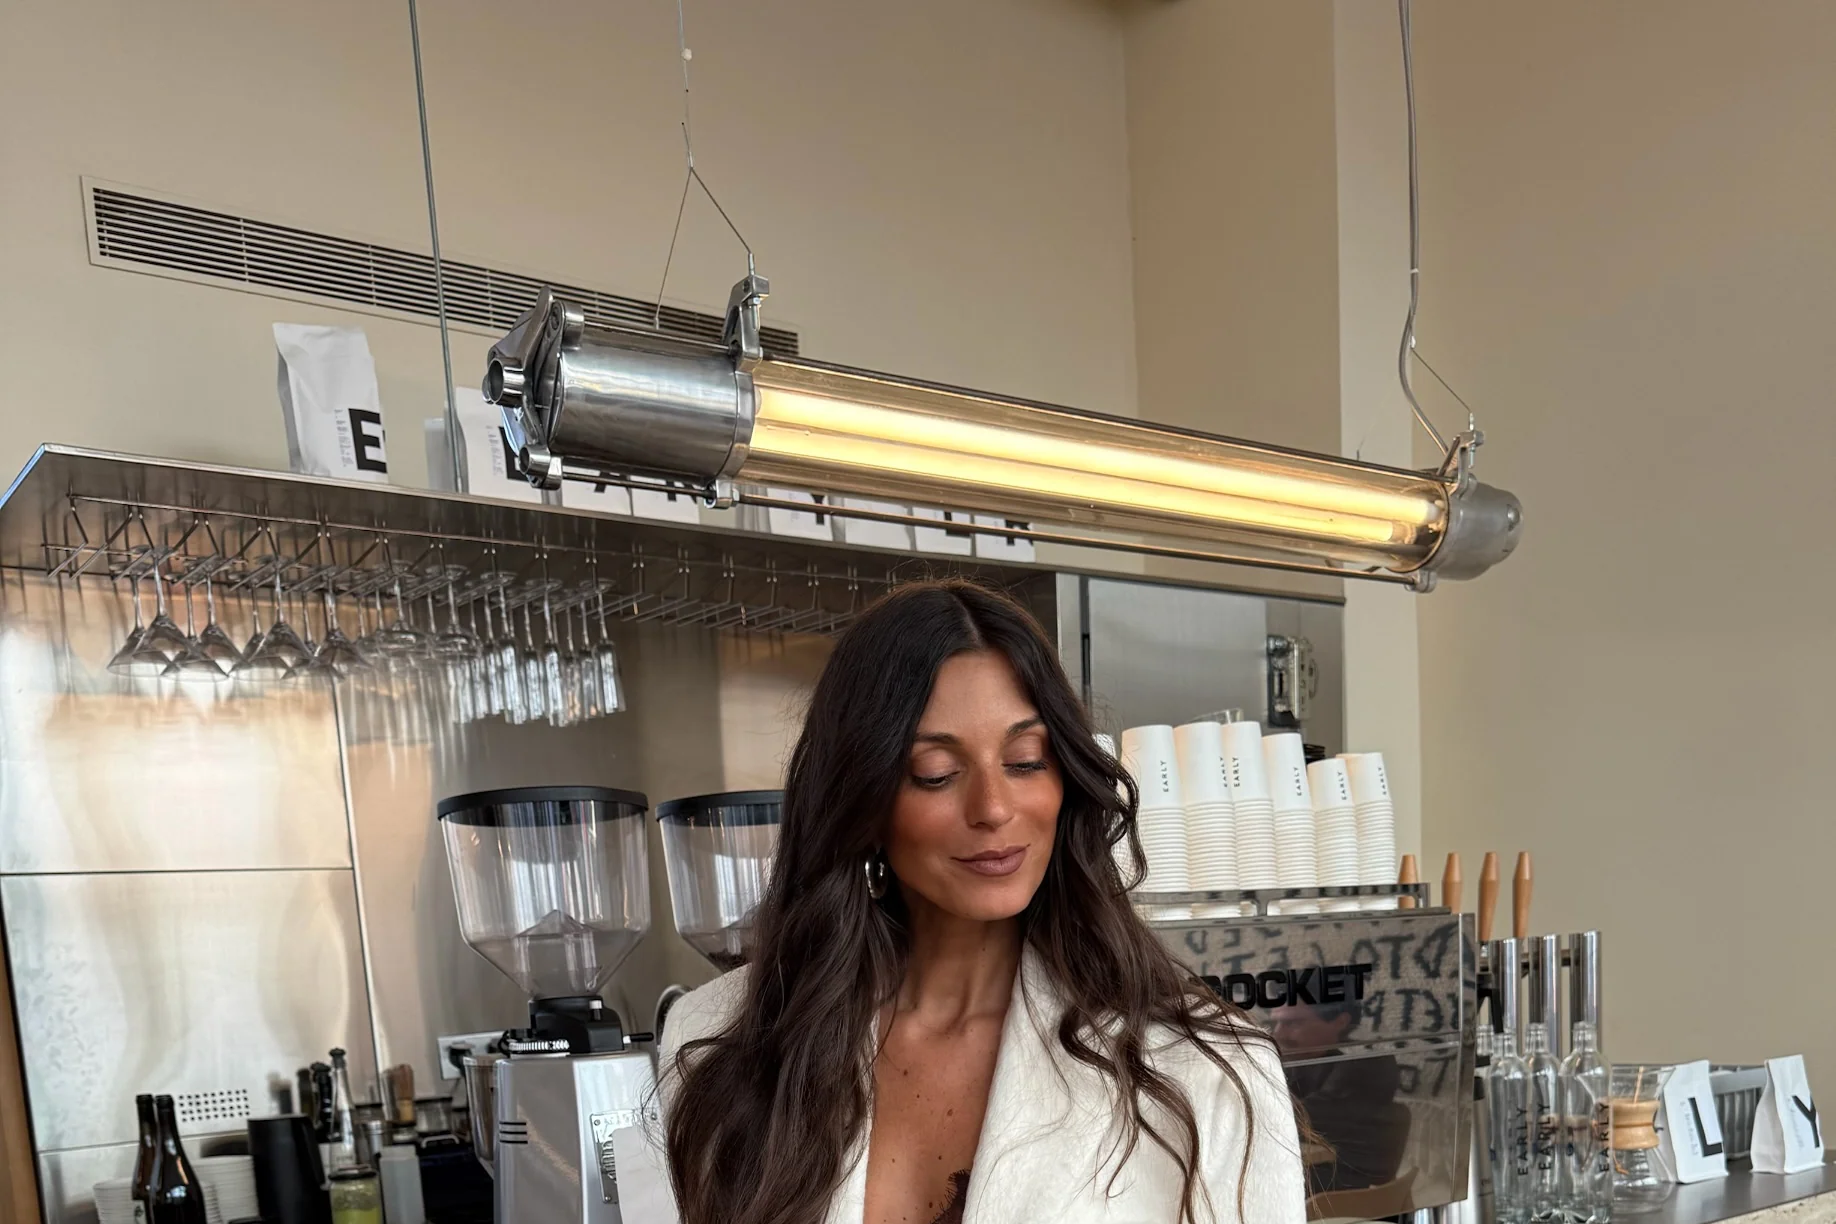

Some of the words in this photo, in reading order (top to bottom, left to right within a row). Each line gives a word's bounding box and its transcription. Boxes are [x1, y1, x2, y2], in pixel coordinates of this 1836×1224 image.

[348, 408, 388, 474] E
[1160, 760, 1169, 792] EARLY
[1232, 756, 1240, 787] EARLY
[1516, 1105, 1529, 1176] EARLY
[1538, 1102, 1551, 1171] EARLY
[1599, 1102, 1610, 1172] EARLY
[1688, 1097, 1723, 1157] L
[1792, 1095, 1820, 1148] Y
